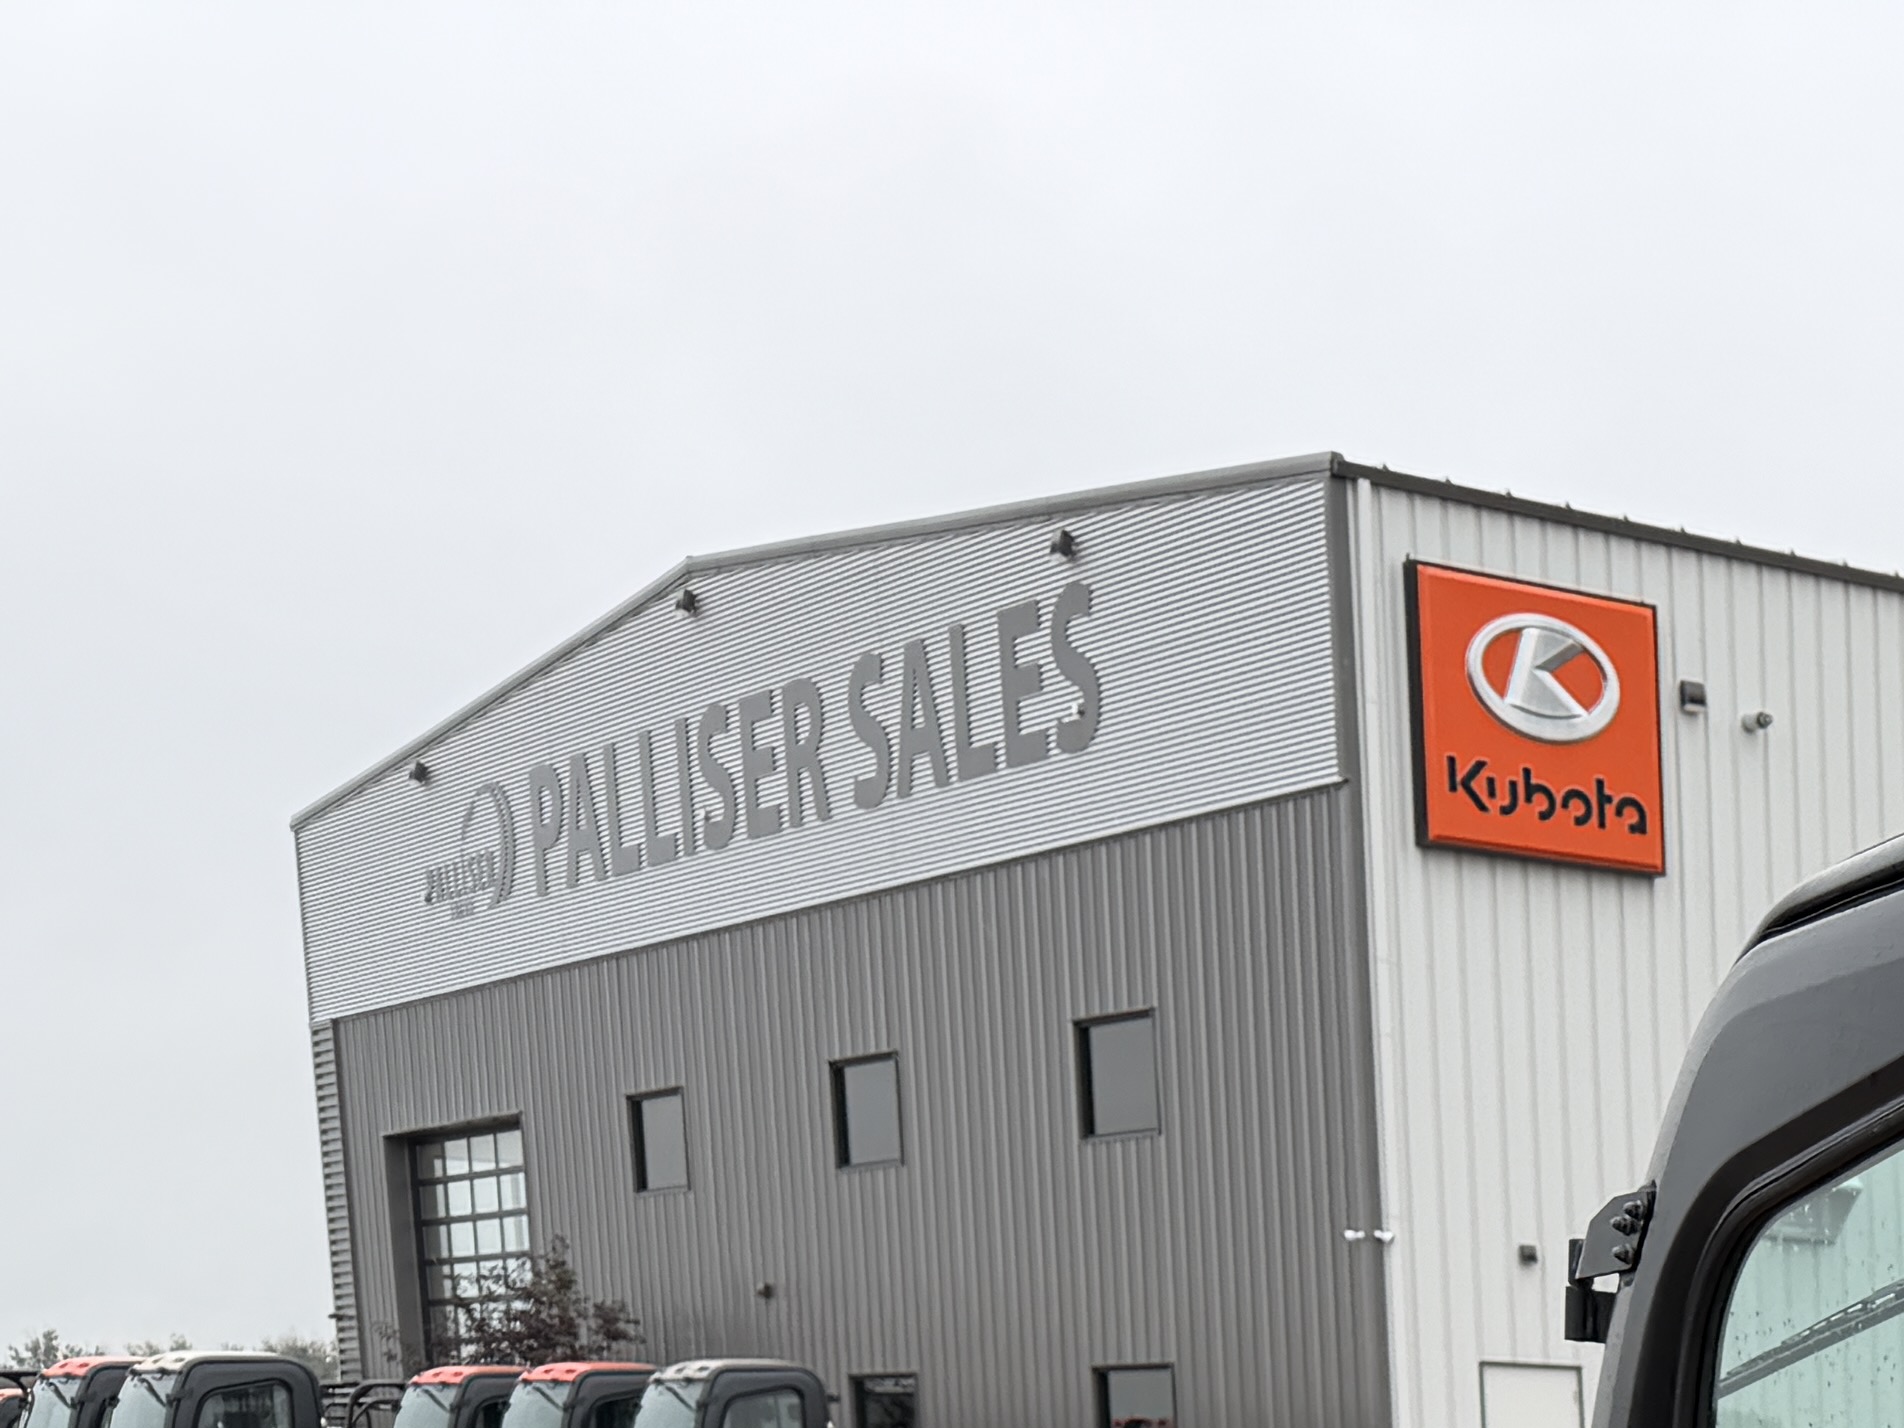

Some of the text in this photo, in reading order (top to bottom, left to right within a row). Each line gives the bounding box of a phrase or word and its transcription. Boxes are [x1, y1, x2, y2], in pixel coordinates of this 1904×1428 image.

[529, 580, 1102, 897] PALLISER SALES
[1446, 755, 1648, 835] Kubota
